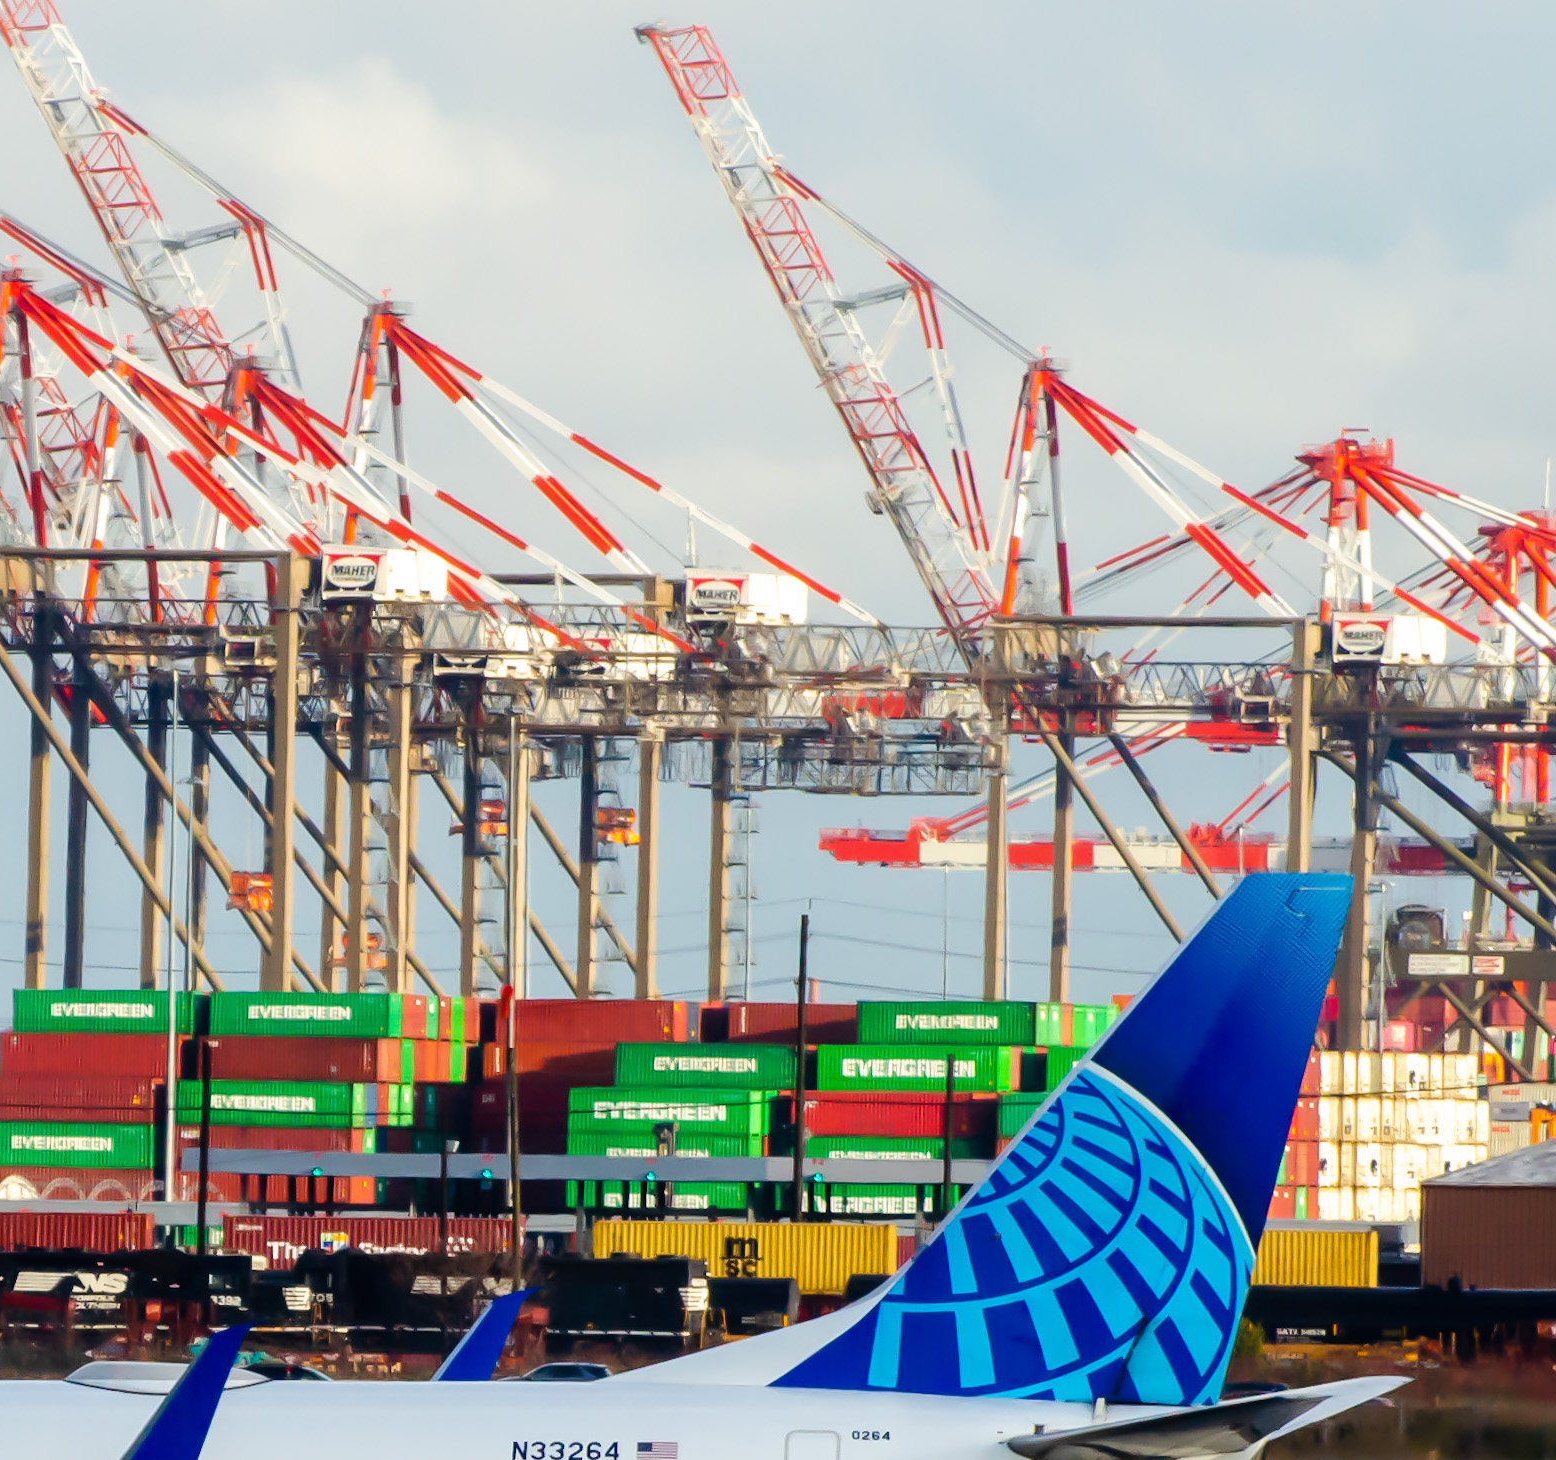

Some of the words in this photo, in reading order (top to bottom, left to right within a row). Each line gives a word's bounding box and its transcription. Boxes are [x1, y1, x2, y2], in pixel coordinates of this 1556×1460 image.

[332, 565, 375, 575] MAHER
[50, 1002, 154, 1018] EVERGREEN
[247, 1005, 352, 1020] EVERGREEN
[895, 1014, 998, 1029] EVERGREEN
[653, 1056, 757, 1072] EVERGREEN
[842, 1058, 976, 1078] EVERGREEN
[210, 1094, 316, 1112] EVERGREEN
[593, 1101, 727, 1121] EVERGREEN
[10, 1135, 114, 1151] EVERGREEN
[852, 1431, 890, 1441] 0264
[512, 1442, 620, 1460] N33264
